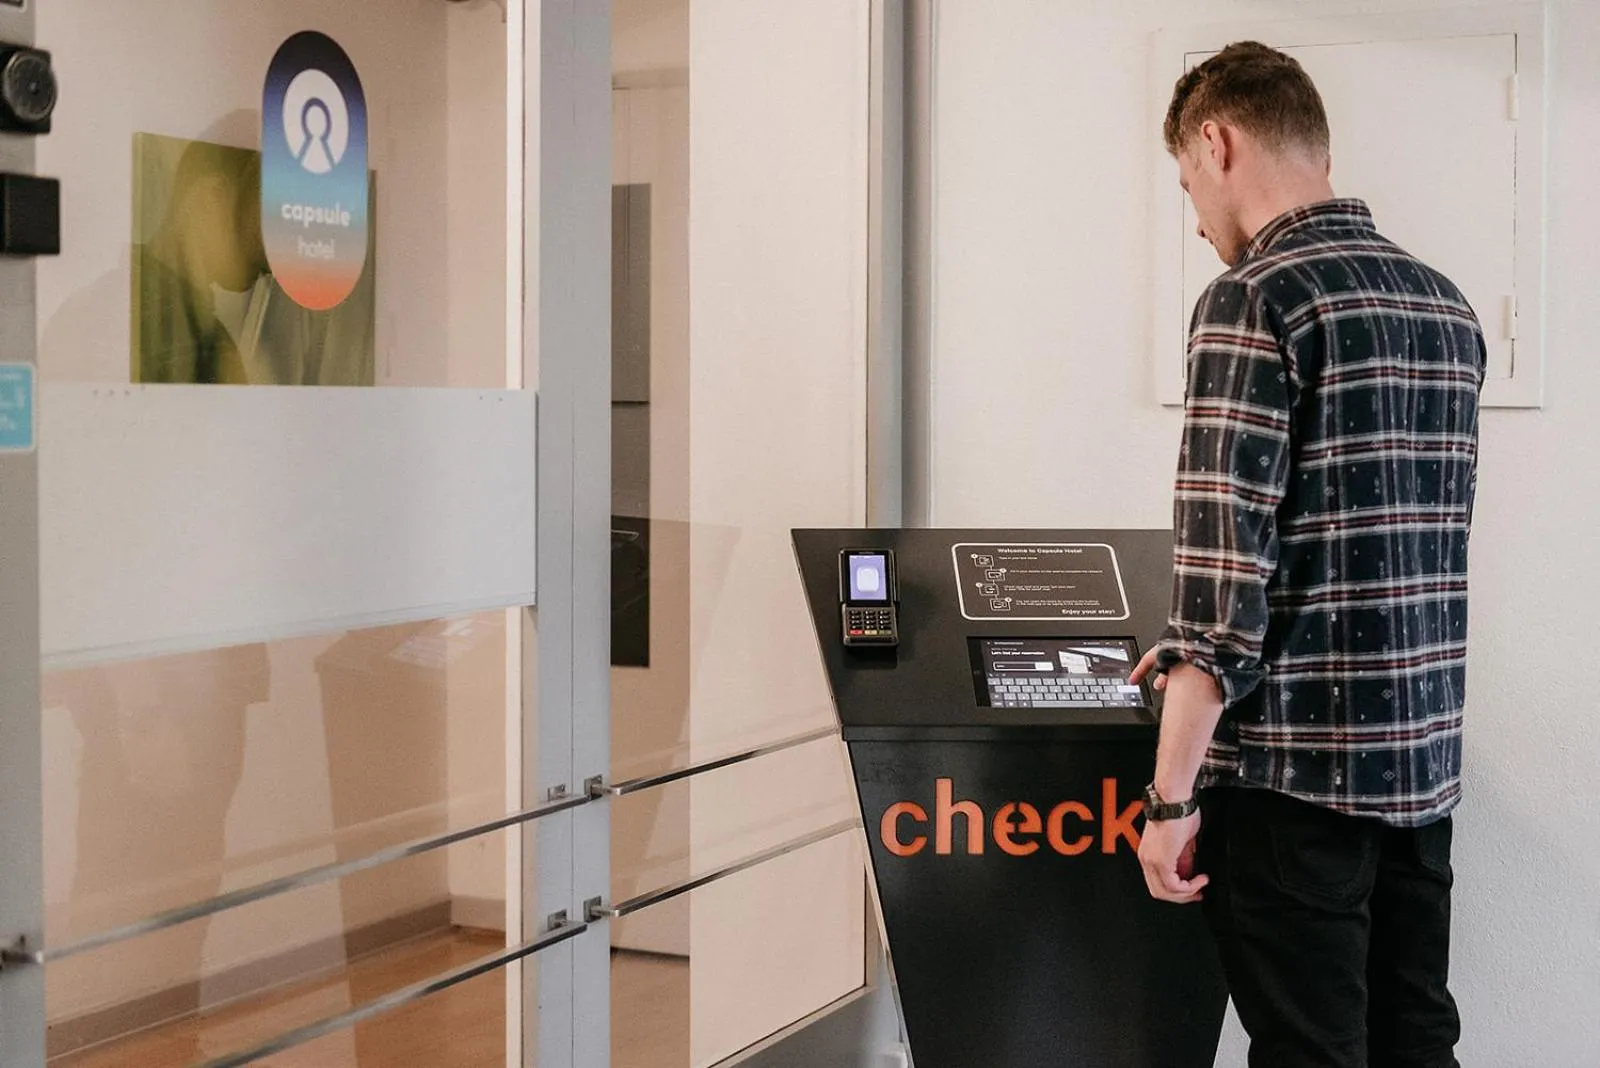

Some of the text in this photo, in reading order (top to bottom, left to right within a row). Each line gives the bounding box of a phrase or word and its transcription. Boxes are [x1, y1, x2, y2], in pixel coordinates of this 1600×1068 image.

[281, 202, 351, 228] capsule
[297, 235, 336, 259] hotel
[880, 777, 1145, 856] check
